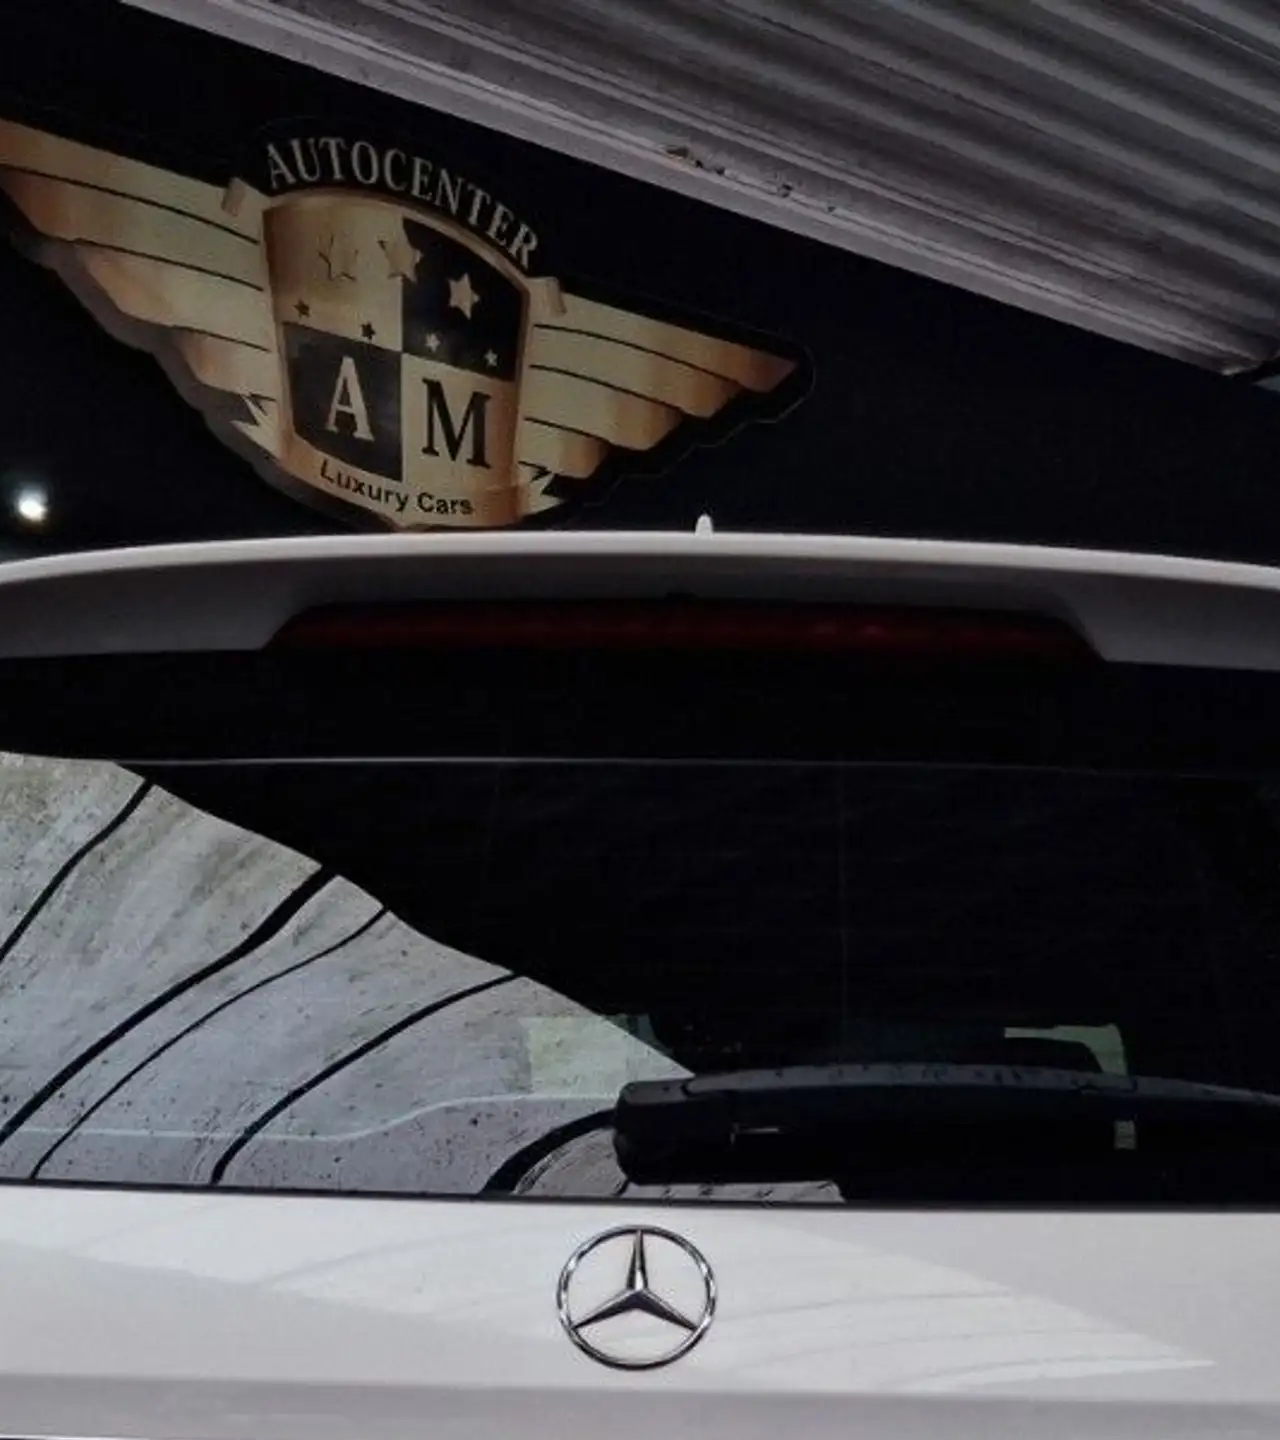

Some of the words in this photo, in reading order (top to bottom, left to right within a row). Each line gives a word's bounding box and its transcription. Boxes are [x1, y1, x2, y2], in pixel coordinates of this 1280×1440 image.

[267, 137, 538, 269] AUTOCENTER
[326, 355, 375, 442] A
[422, 377, 492, 470] M
[320, 458, 409, 513] Luxury
[417, 492, 474, 515] Cars
